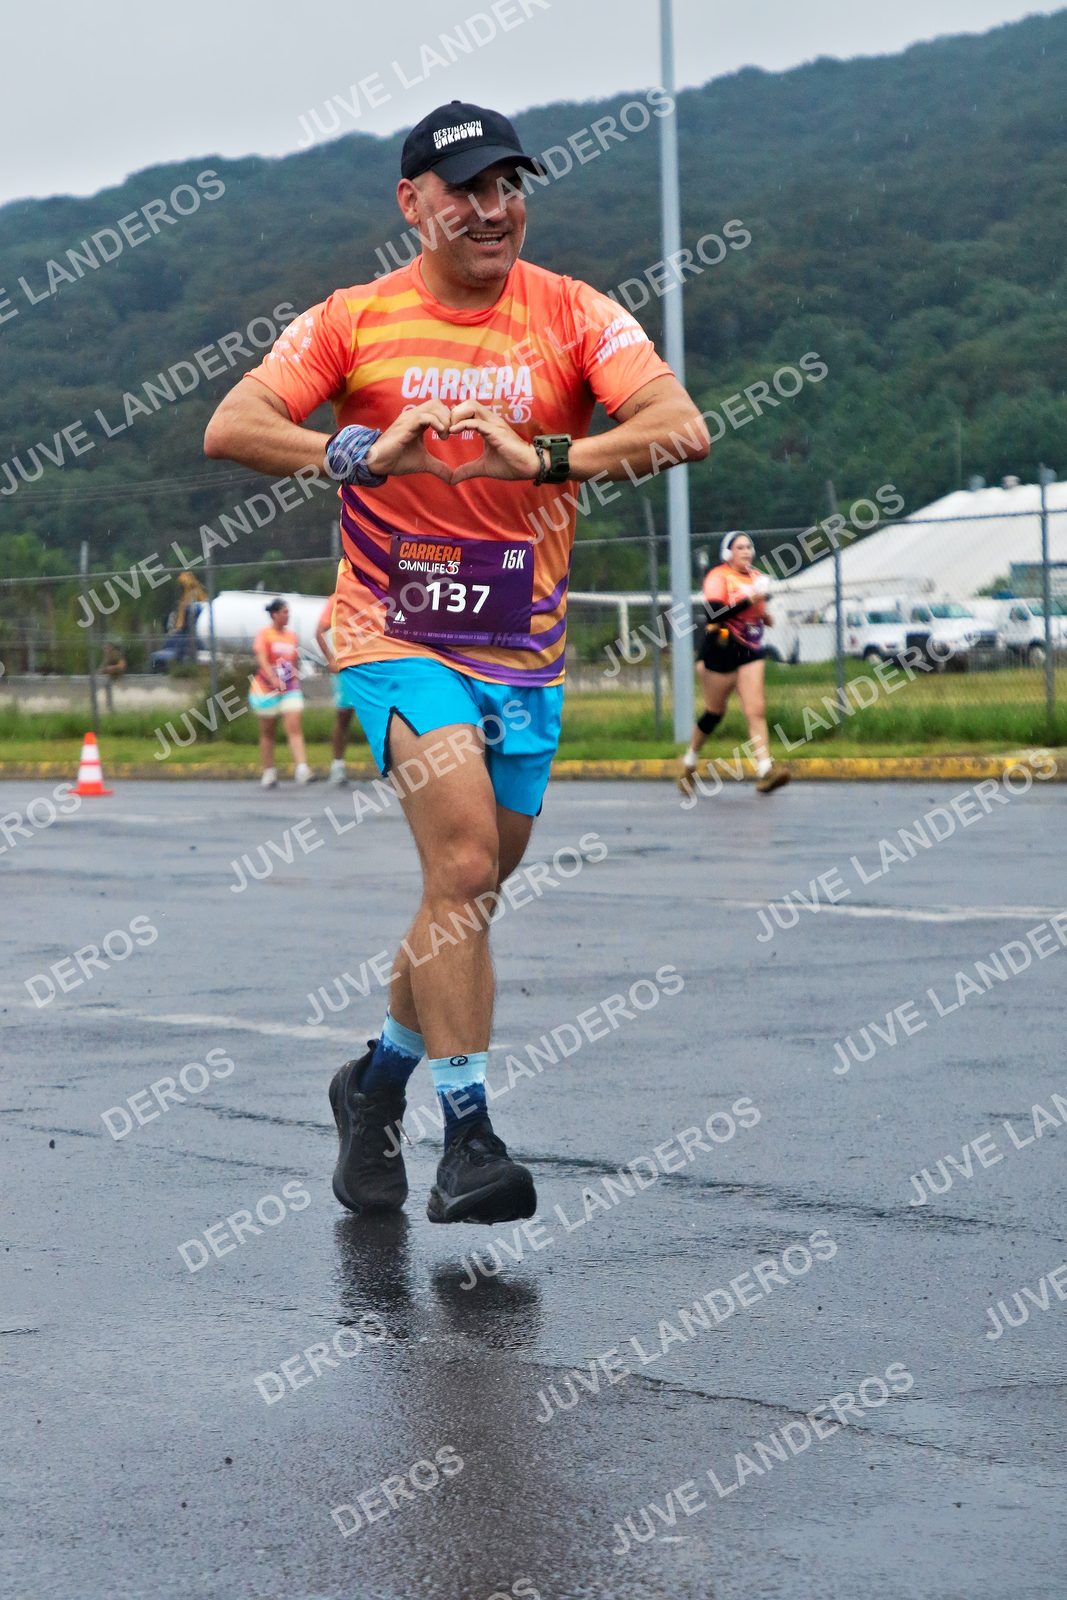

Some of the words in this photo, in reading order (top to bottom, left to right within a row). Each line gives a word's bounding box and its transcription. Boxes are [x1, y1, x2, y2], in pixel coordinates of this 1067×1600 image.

[433, 120, 482, 142] DESTINATION
[435, 126, 483, 150] UNKNOWN
[402, 366, 533, 400] CARRERA
[461, 430, 474, 440] 10K
[399, 542, 462, 561] CARRERA
[502, 549, 527, 569] 15K
[426, 582, 490, 614] 137
